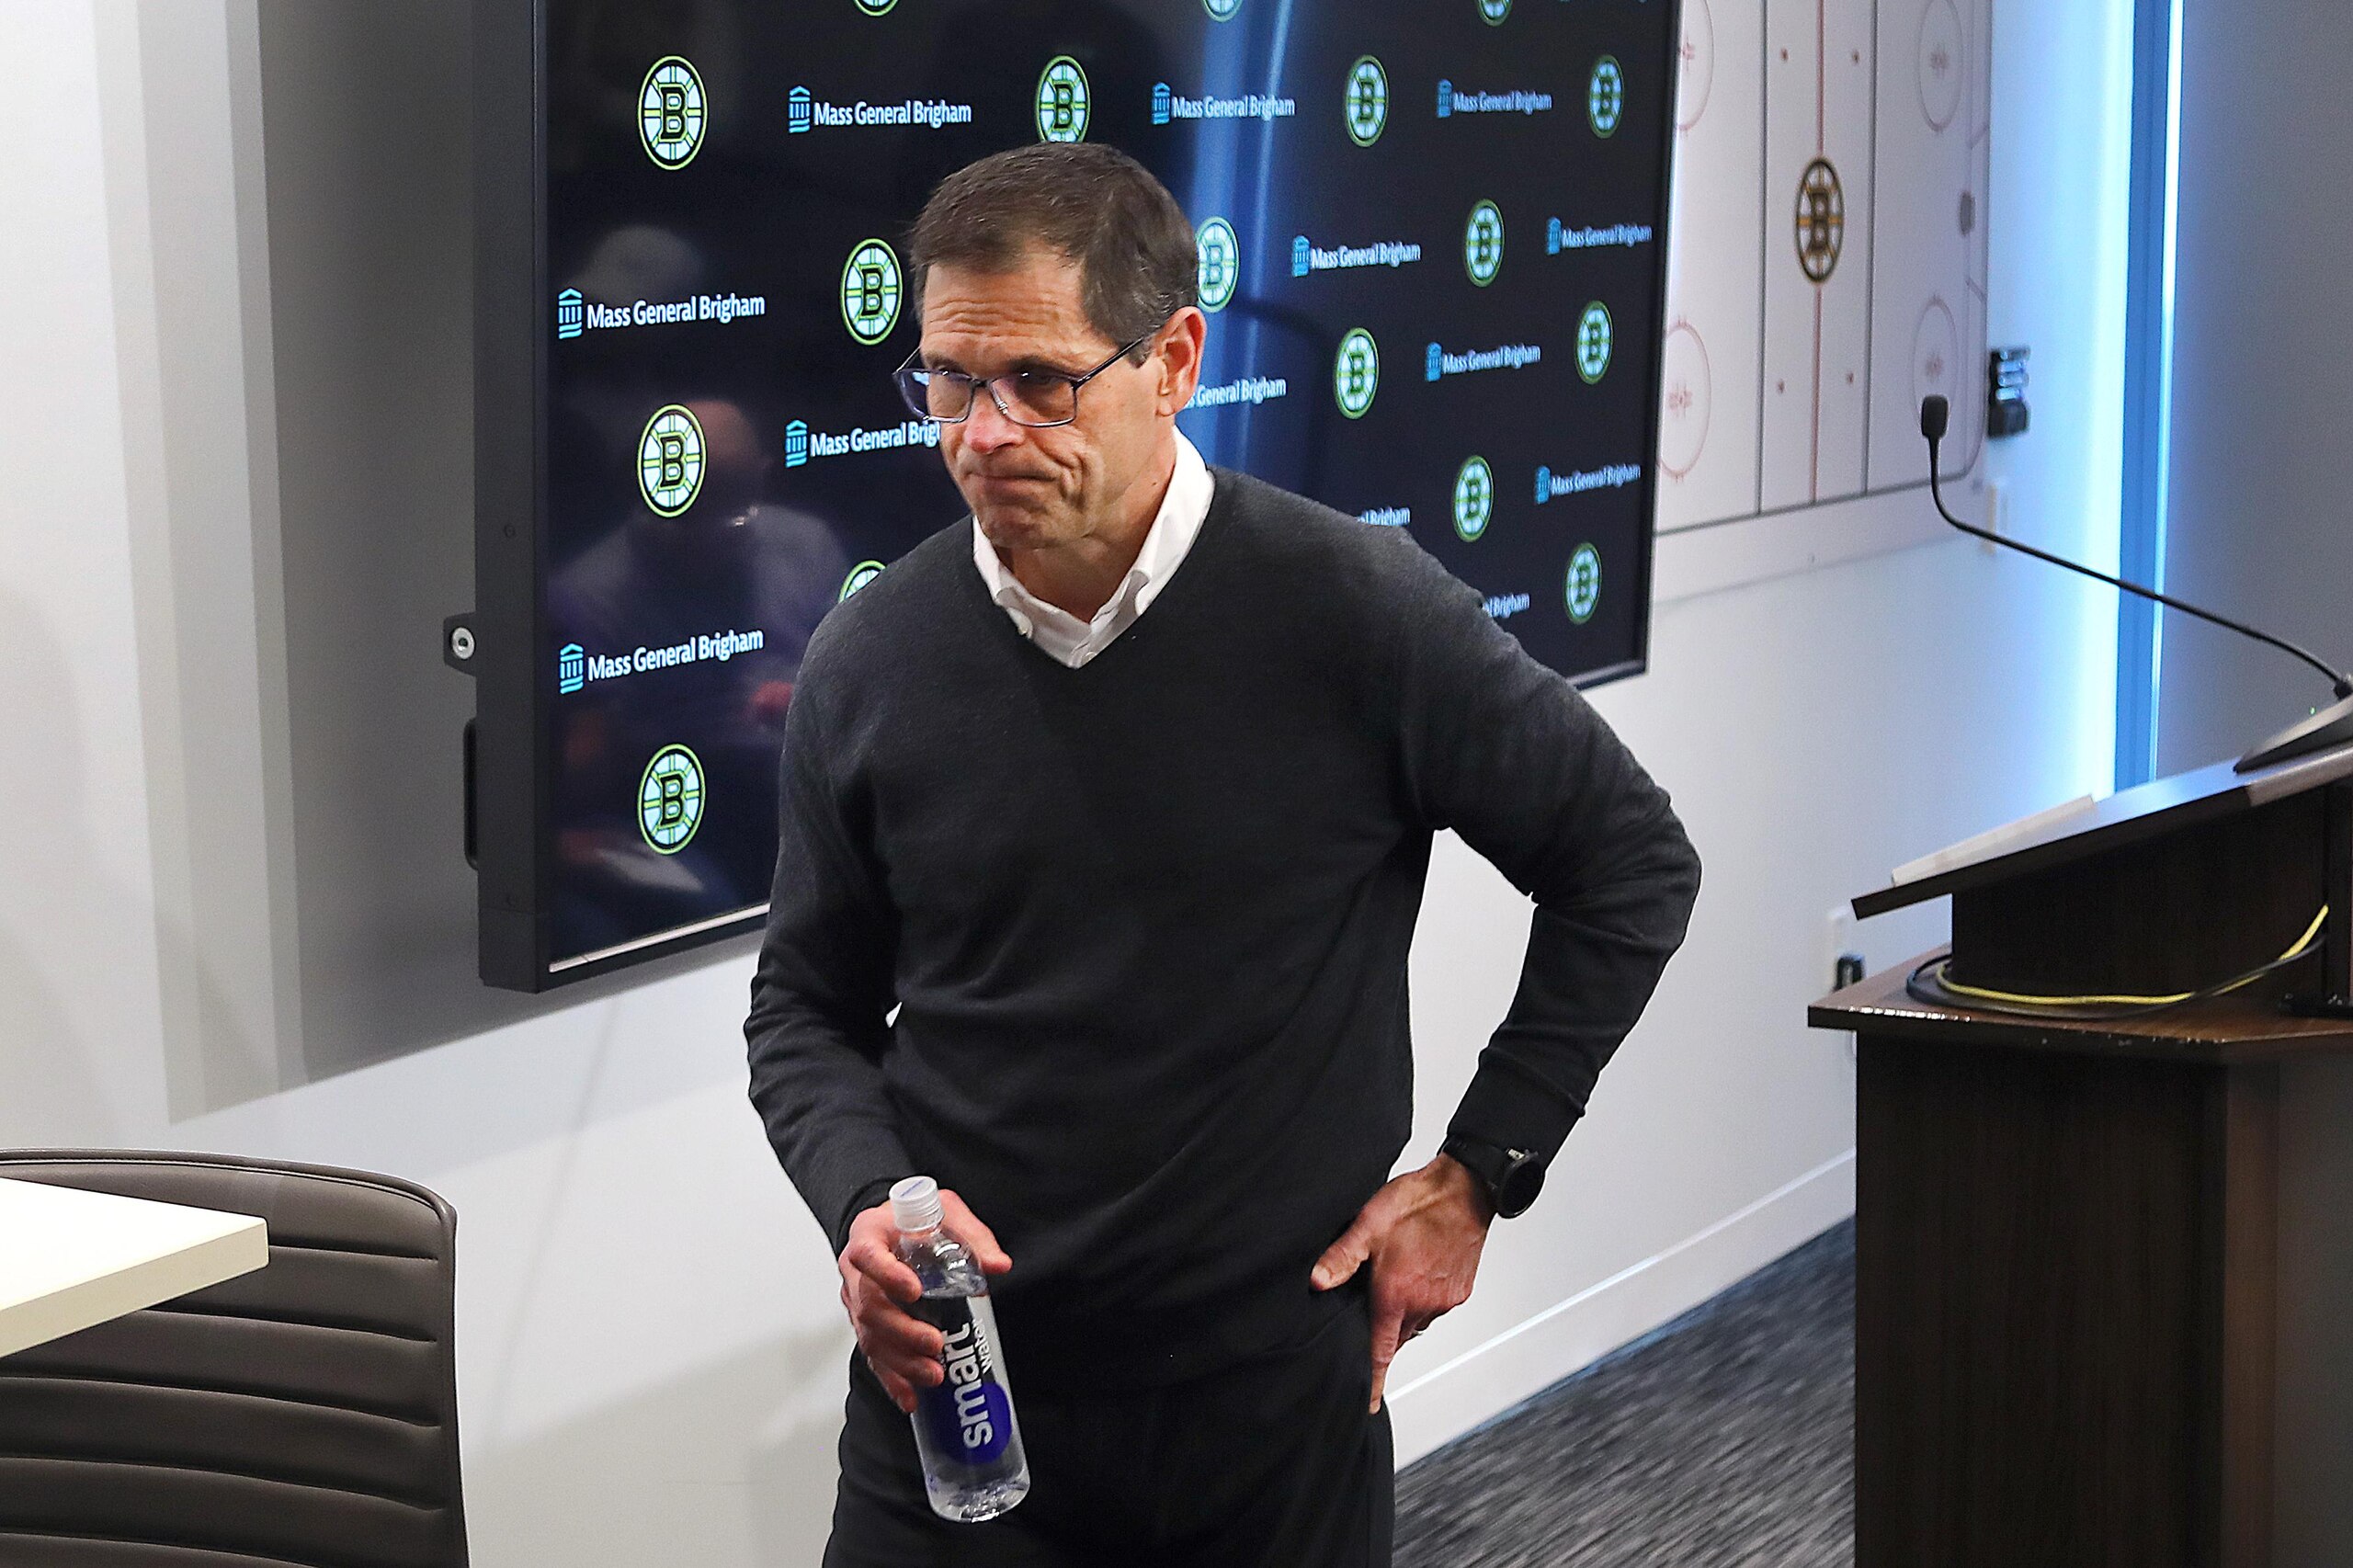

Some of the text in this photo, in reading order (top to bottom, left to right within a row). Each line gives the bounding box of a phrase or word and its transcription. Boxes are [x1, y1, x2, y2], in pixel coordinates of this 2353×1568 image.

[813, 99, 972, 129] Mass General Brigham
[1171, 95, 1295, 121] Mass General Brigham
[1453, 90, 1552, 115] Mass General Brigham
[1562, 223, 1653, 248] Mass General Brigham
[1310, 241, 1421, 268] Mass General Brigham
[586, 293, 766, 329] Mass General Brigham
[1442, 343, 1541, 374] Mass General Brigham
[1197, 384, 1241, 407] General
[1240, 376, 1287, 404] Brigham
[810, 420, 940, 457] Mass General Brig
[1551, 463, 1641, 495] Mass General Brigham
[587, 630, 764, 681] Mass General Brigham
[941, 1322, 994, 1449] smart
